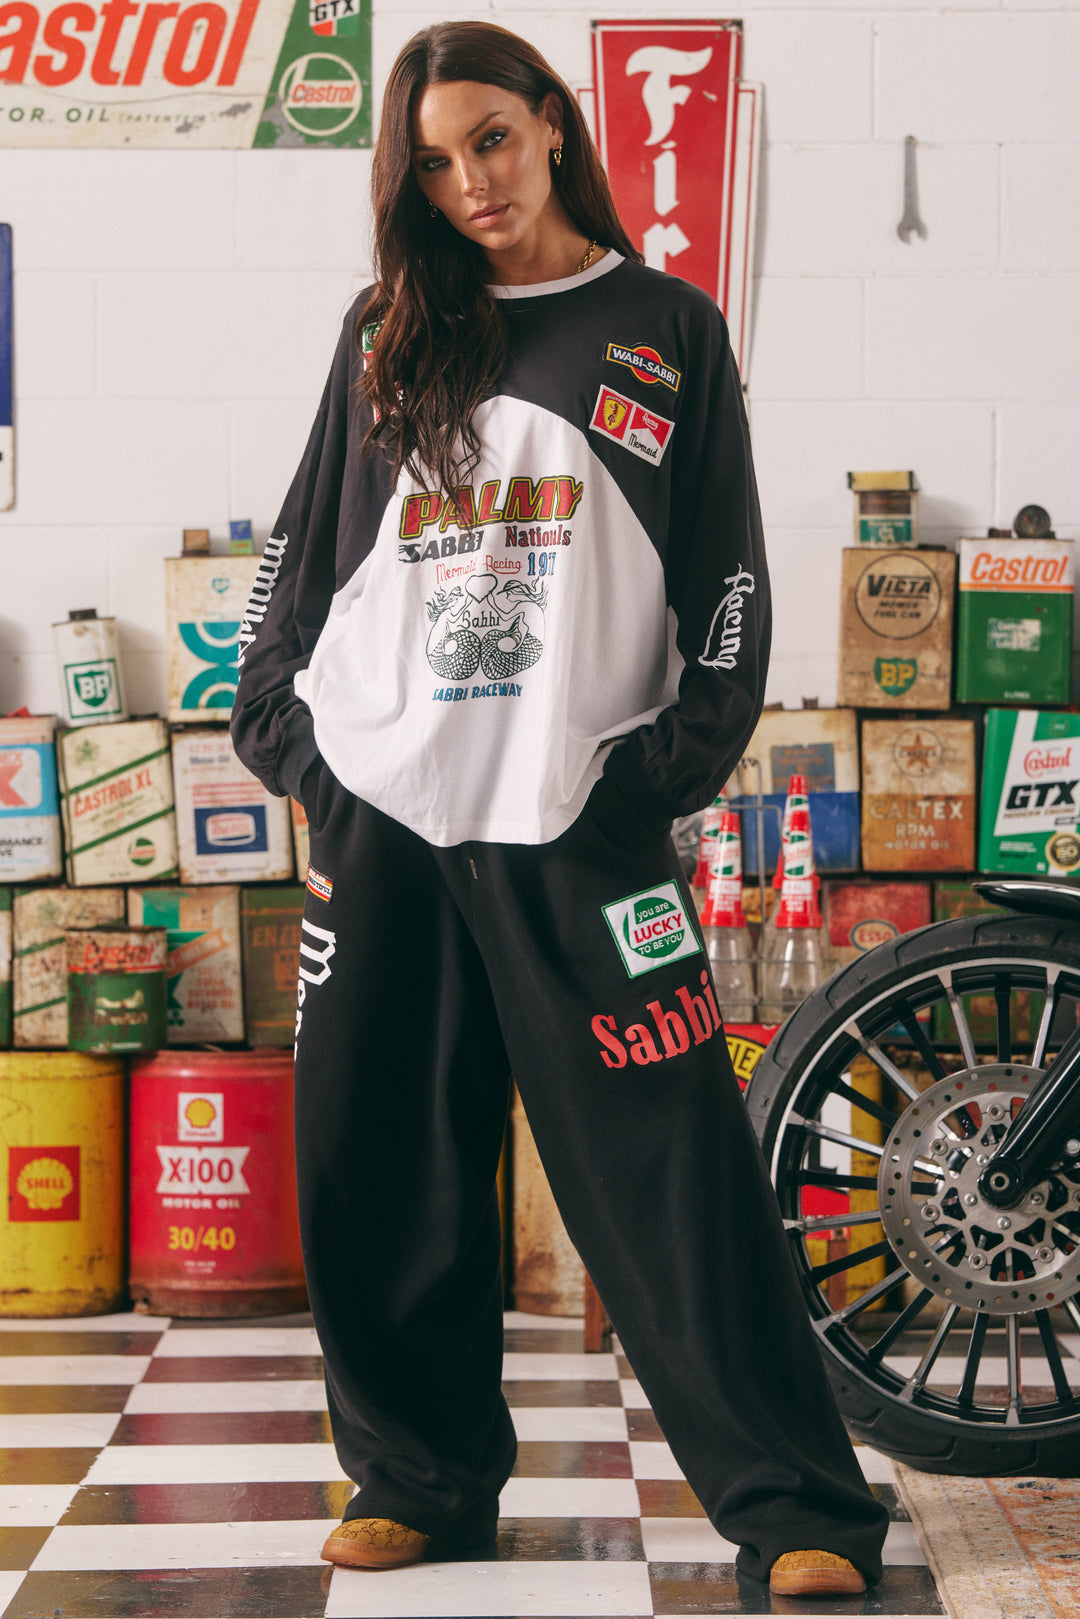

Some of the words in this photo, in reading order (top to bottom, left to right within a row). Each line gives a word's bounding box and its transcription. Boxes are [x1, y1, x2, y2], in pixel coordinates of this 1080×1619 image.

[315, 0, 354, 21] GTX
[291, 83, 357, 104] Castrol
[0, 106, 44, 122] OR
[66, 107, 110, 122] OIL
[612, 347, 676, 385] WABI-SABBI
[628, 433, 659, 459] Mermaid
[398, 475, 584, 540] PALMY
[398, 530, 485, 563] SABBI
[484, 555, 522, 575] Racing
[970, 553, 1069, 584] Castrol
[868, 575, 931, 596] VICTA
[698, 563, 755, 671] Racing
[79, 674, 111, 698] BP
[881, 662, 916, 688] BP
[470, 683, 523, 699] RACEWAY
[1023, 746, 1072, 779] Castrol
[74, 776, 134, 818] CASTROL
[136, 768, 153, 791] XL
[1006, 780, 1080, 810] GTX
[870, 801, 964, 820] CALTEX
[895, 822, 936, 838] RPM
[637, 907, 655, 922] you
[655, 901, 670, 914] are
[634, 912, 683, 944] LUCKY
[84, 943, 154, 967] Castrol
[638, 943, 652, 955] TO
[652, 938, 666, 950] BE
[664, 932, 684, 947] YOU
[591, 969, 722, 1069] Sabbi
[26, 1177, 66, 1191] SHELL
[162, 1197, 213, 1209] MOTOR
[216, 1198, 241, 1209] OIL
[168, 1225, 236, 1251] 30/40
